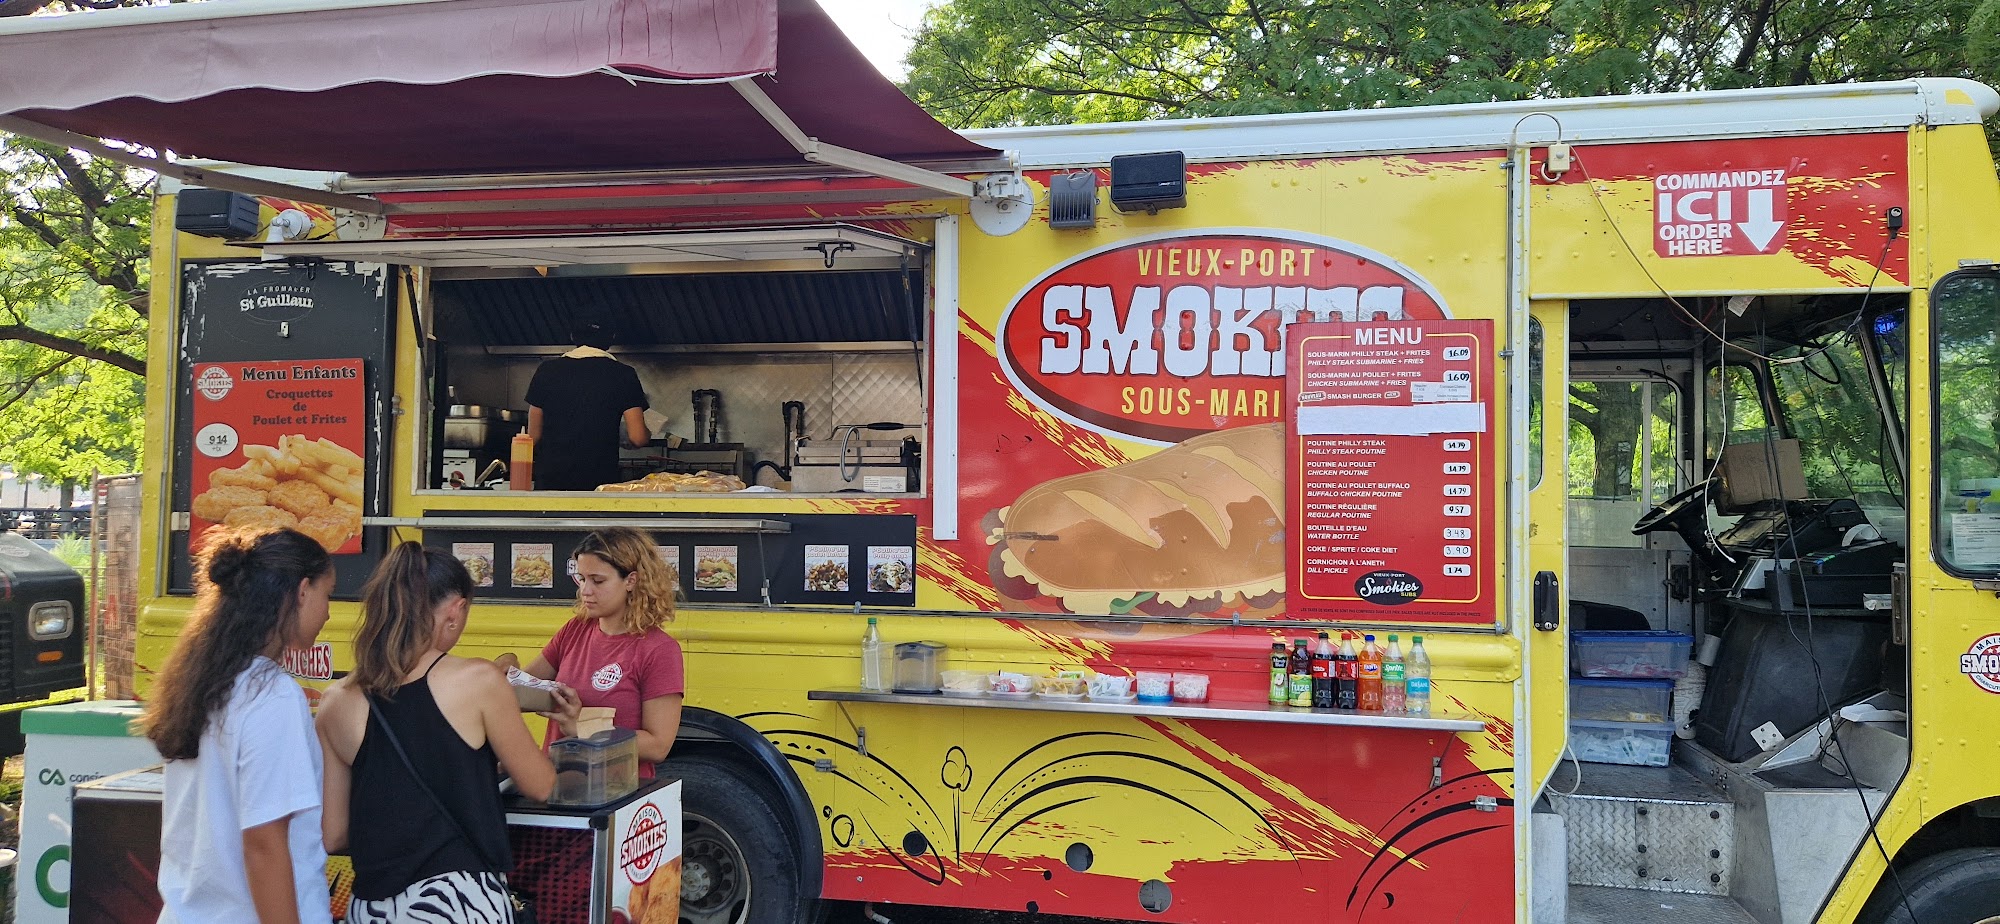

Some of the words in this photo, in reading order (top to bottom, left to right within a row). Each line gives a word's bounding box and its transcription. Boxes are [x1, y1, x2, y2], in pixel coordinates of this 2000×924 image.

[1655, 169, 1785, 191] COMMANDEZ
[1659, 190, 1732, 223] ICI
[1659, 223, 1732, 241] ORDER
[1668, 239, 1723, 256] HERE
[1137, 248, 1315, 276] VIEUX-PORT
[247, 288, 258, 296] LA
[240, 298, 255, 312] St
[1355, 327, 1422, 345] MENU
[242, 367, 287, 381] Menu
[292, 365, 357, 380] Enfants
[266, 389, 333, 400] Croquettes
[1121, 386, 1280, 417] SOUS-MARI
[292, 402, 307, 411] de
[253, 415, 292, 425] Poulet
[295, 415, 308, 424] et
[311, 414, 347, 424] Frites
[1359, 577, 1420, 597] Smokies
[1976, 637, 2000, 651] MAI
[279, 644, 331, 678] WICHES
[1385, 664, 1404, 672] Sprite
[1961, 654, 2000, 673] SMO
[1291, 681, 1310, 692] fuze
[1976, 674, 2000, 690] CHARCUT
[69, 771, 107, 782] consi
[633, 808, 658, 831] MAISON
[622, 826, 667, 868] SMOKIES
